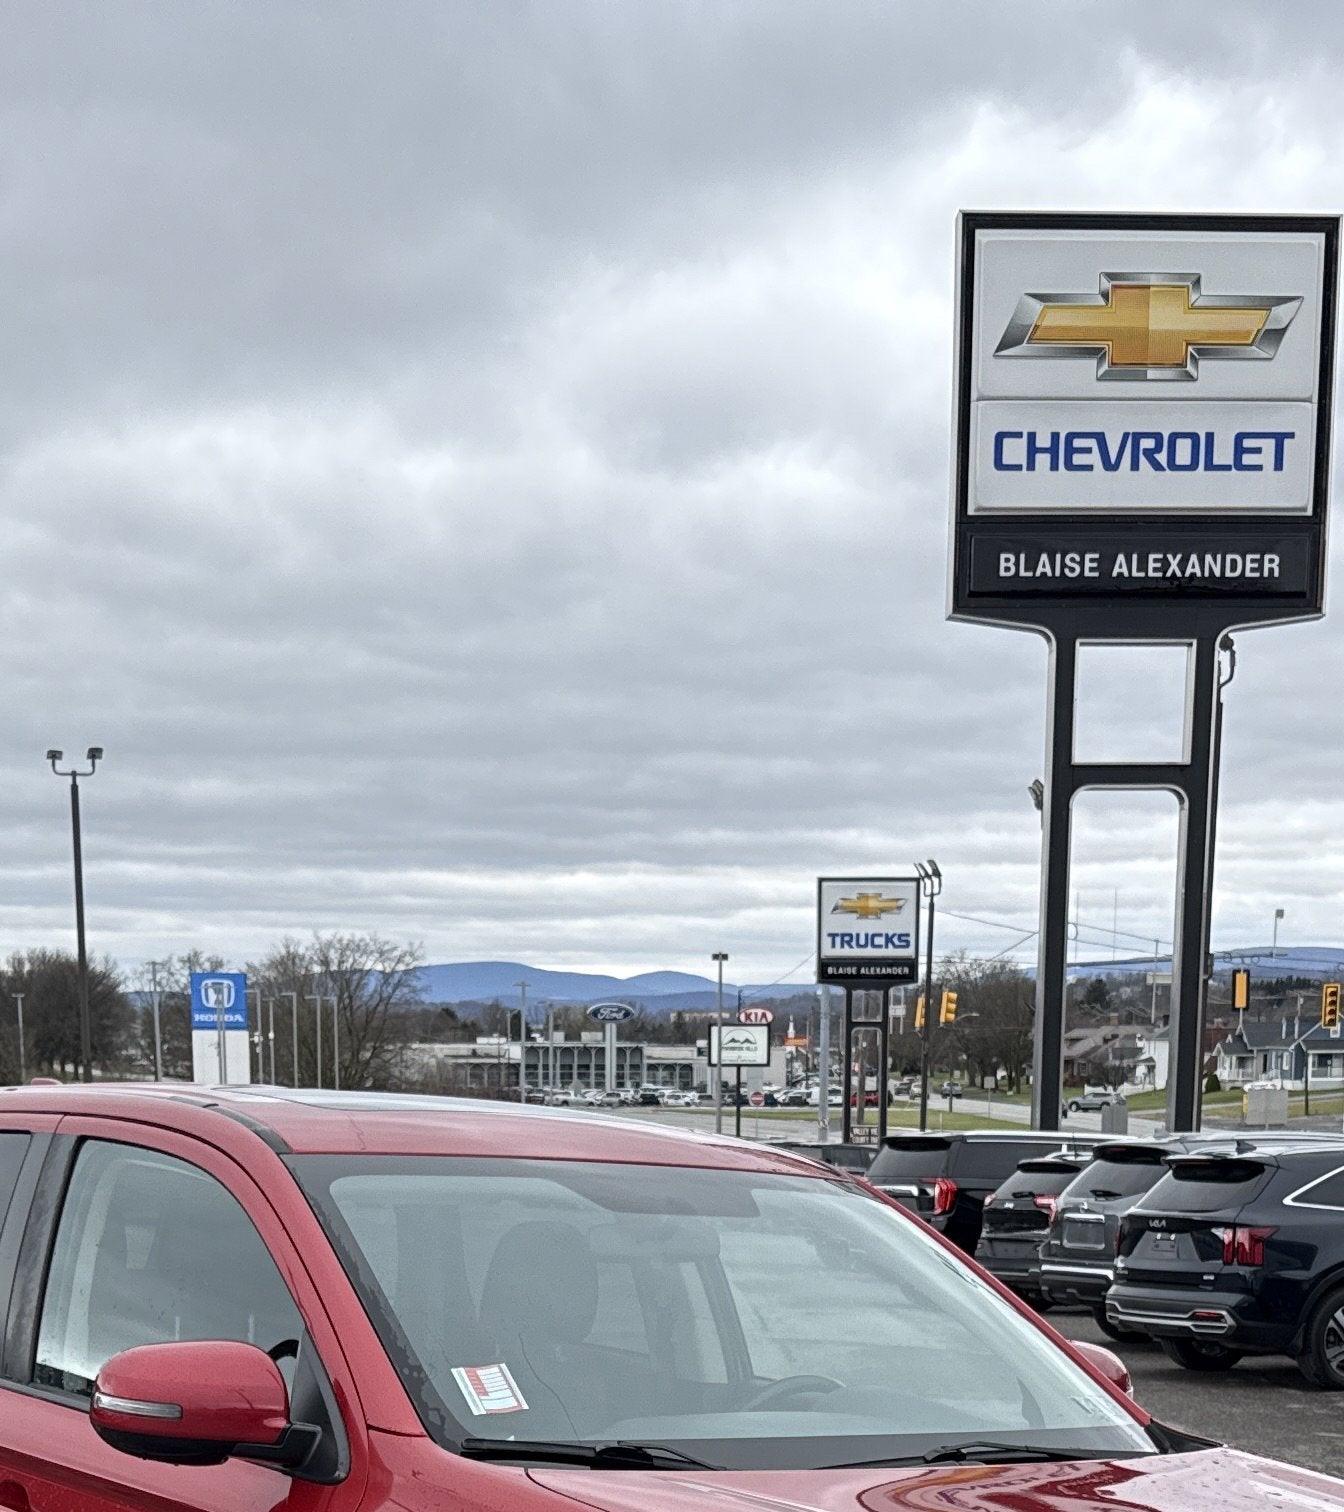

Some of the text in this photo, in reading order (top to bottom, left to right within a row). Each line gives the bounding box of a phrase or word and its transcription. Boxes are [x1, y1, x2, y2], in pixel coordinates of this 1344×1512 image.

[993, 431, 1296, 473] CHEVROLET
[999, 552, 1281, 579] BLAISE ALEXANDER
[826, 932, 911, 949] TRUCKS
[827, 966, 909, 975] BLAISE ALEXANDER
[598, 1008, 625, 1020] Ford
[744, 1011, 768, 1023] KIA
